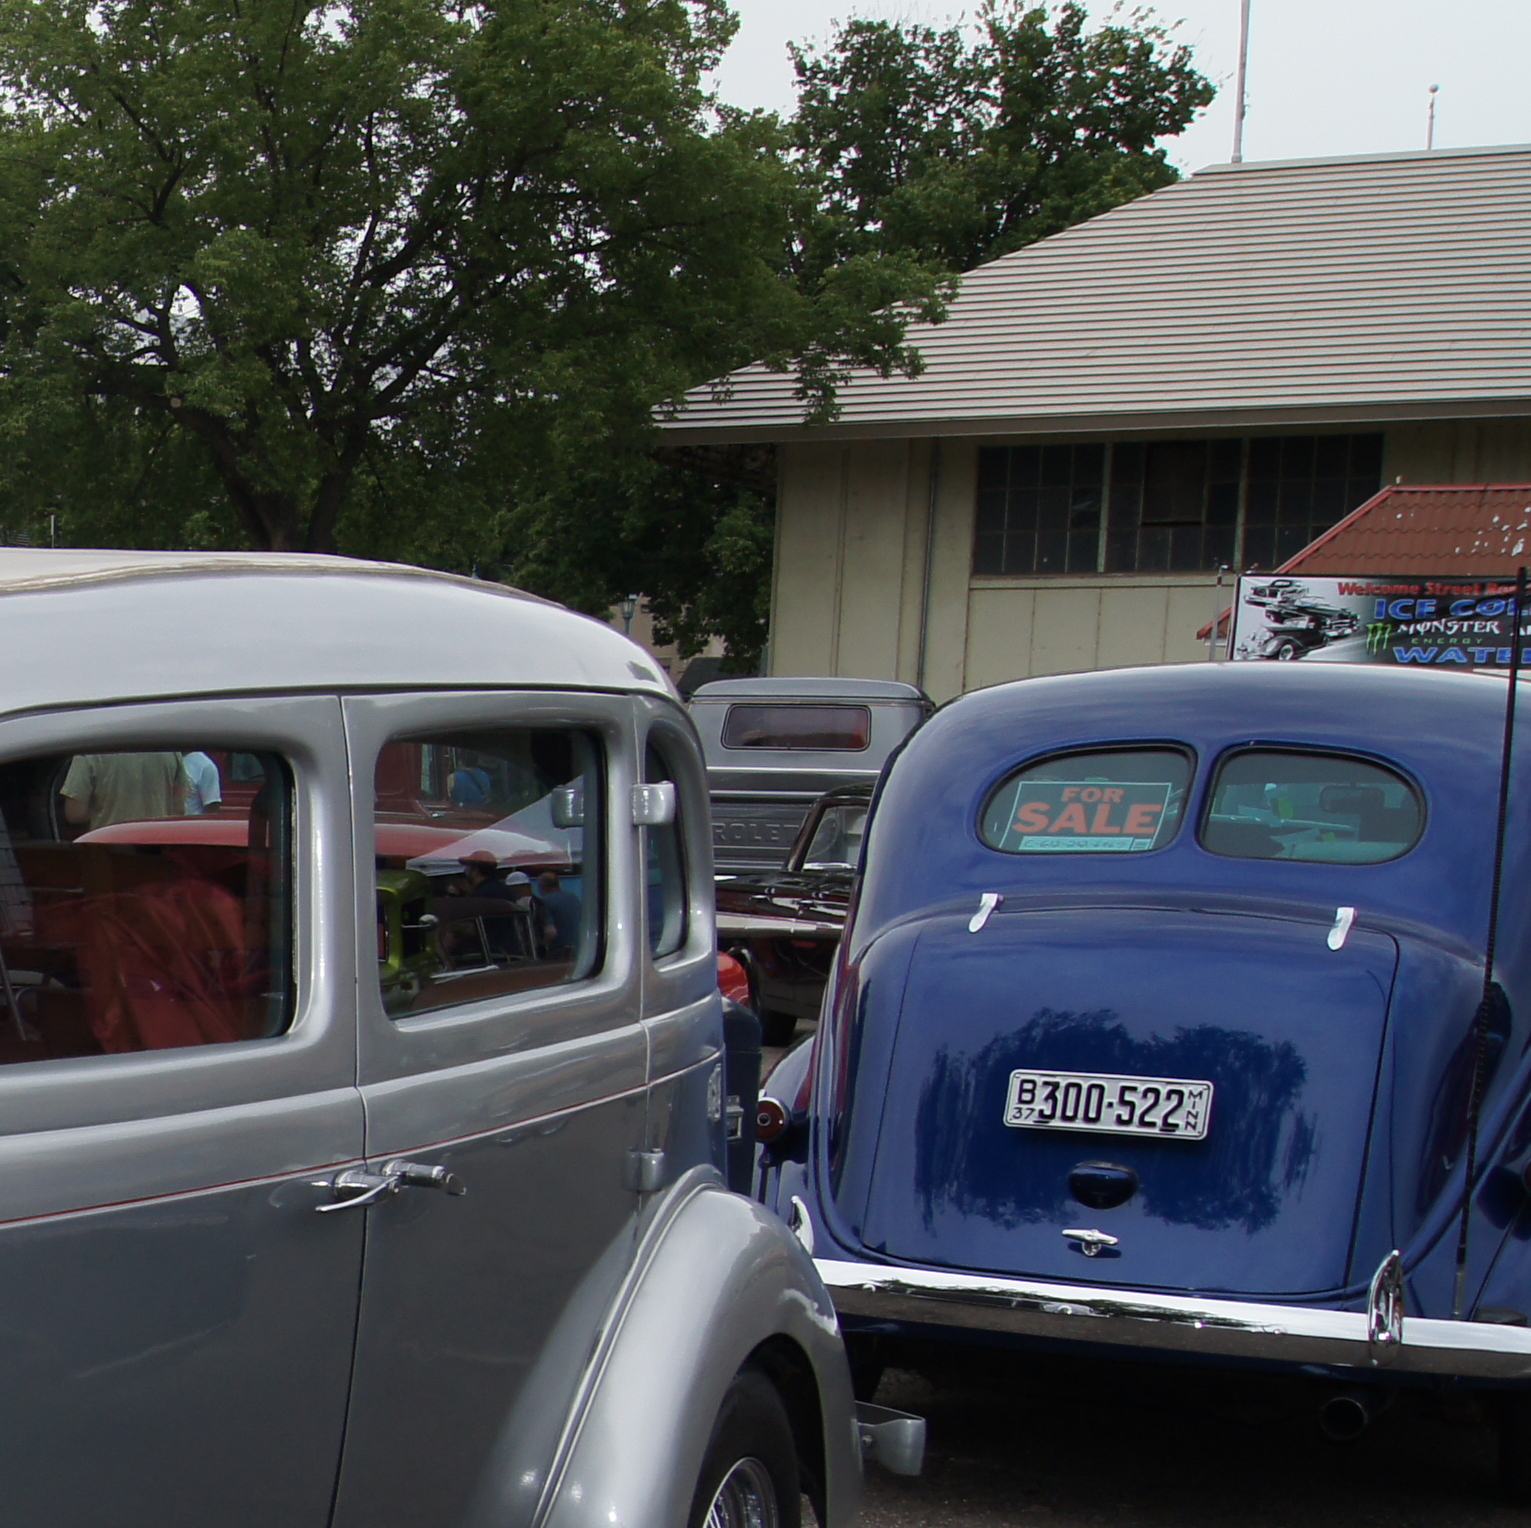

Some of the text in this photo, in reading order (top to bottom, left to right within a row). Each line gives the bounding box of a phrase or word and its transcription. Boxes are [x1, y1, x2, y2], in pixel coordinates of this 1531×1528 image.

[1338, 582, 1425, 596] Welcome
[1425, 582, 1482, 596] Street
[1373, 598, 1531, 620] ICE COL
[1397, 618, 1501, 636] MONSTER
[1411, 637, 1483, 645] ENERGY
[1060, 786, 1125, 803] FOR
[1012, 801, 1163, 835] SALE
[1018, 1079, 1037, 1105] B
[1012, 1107, 1035, 1120] 37
[1185, 1089, 1203, 1131] MINN
